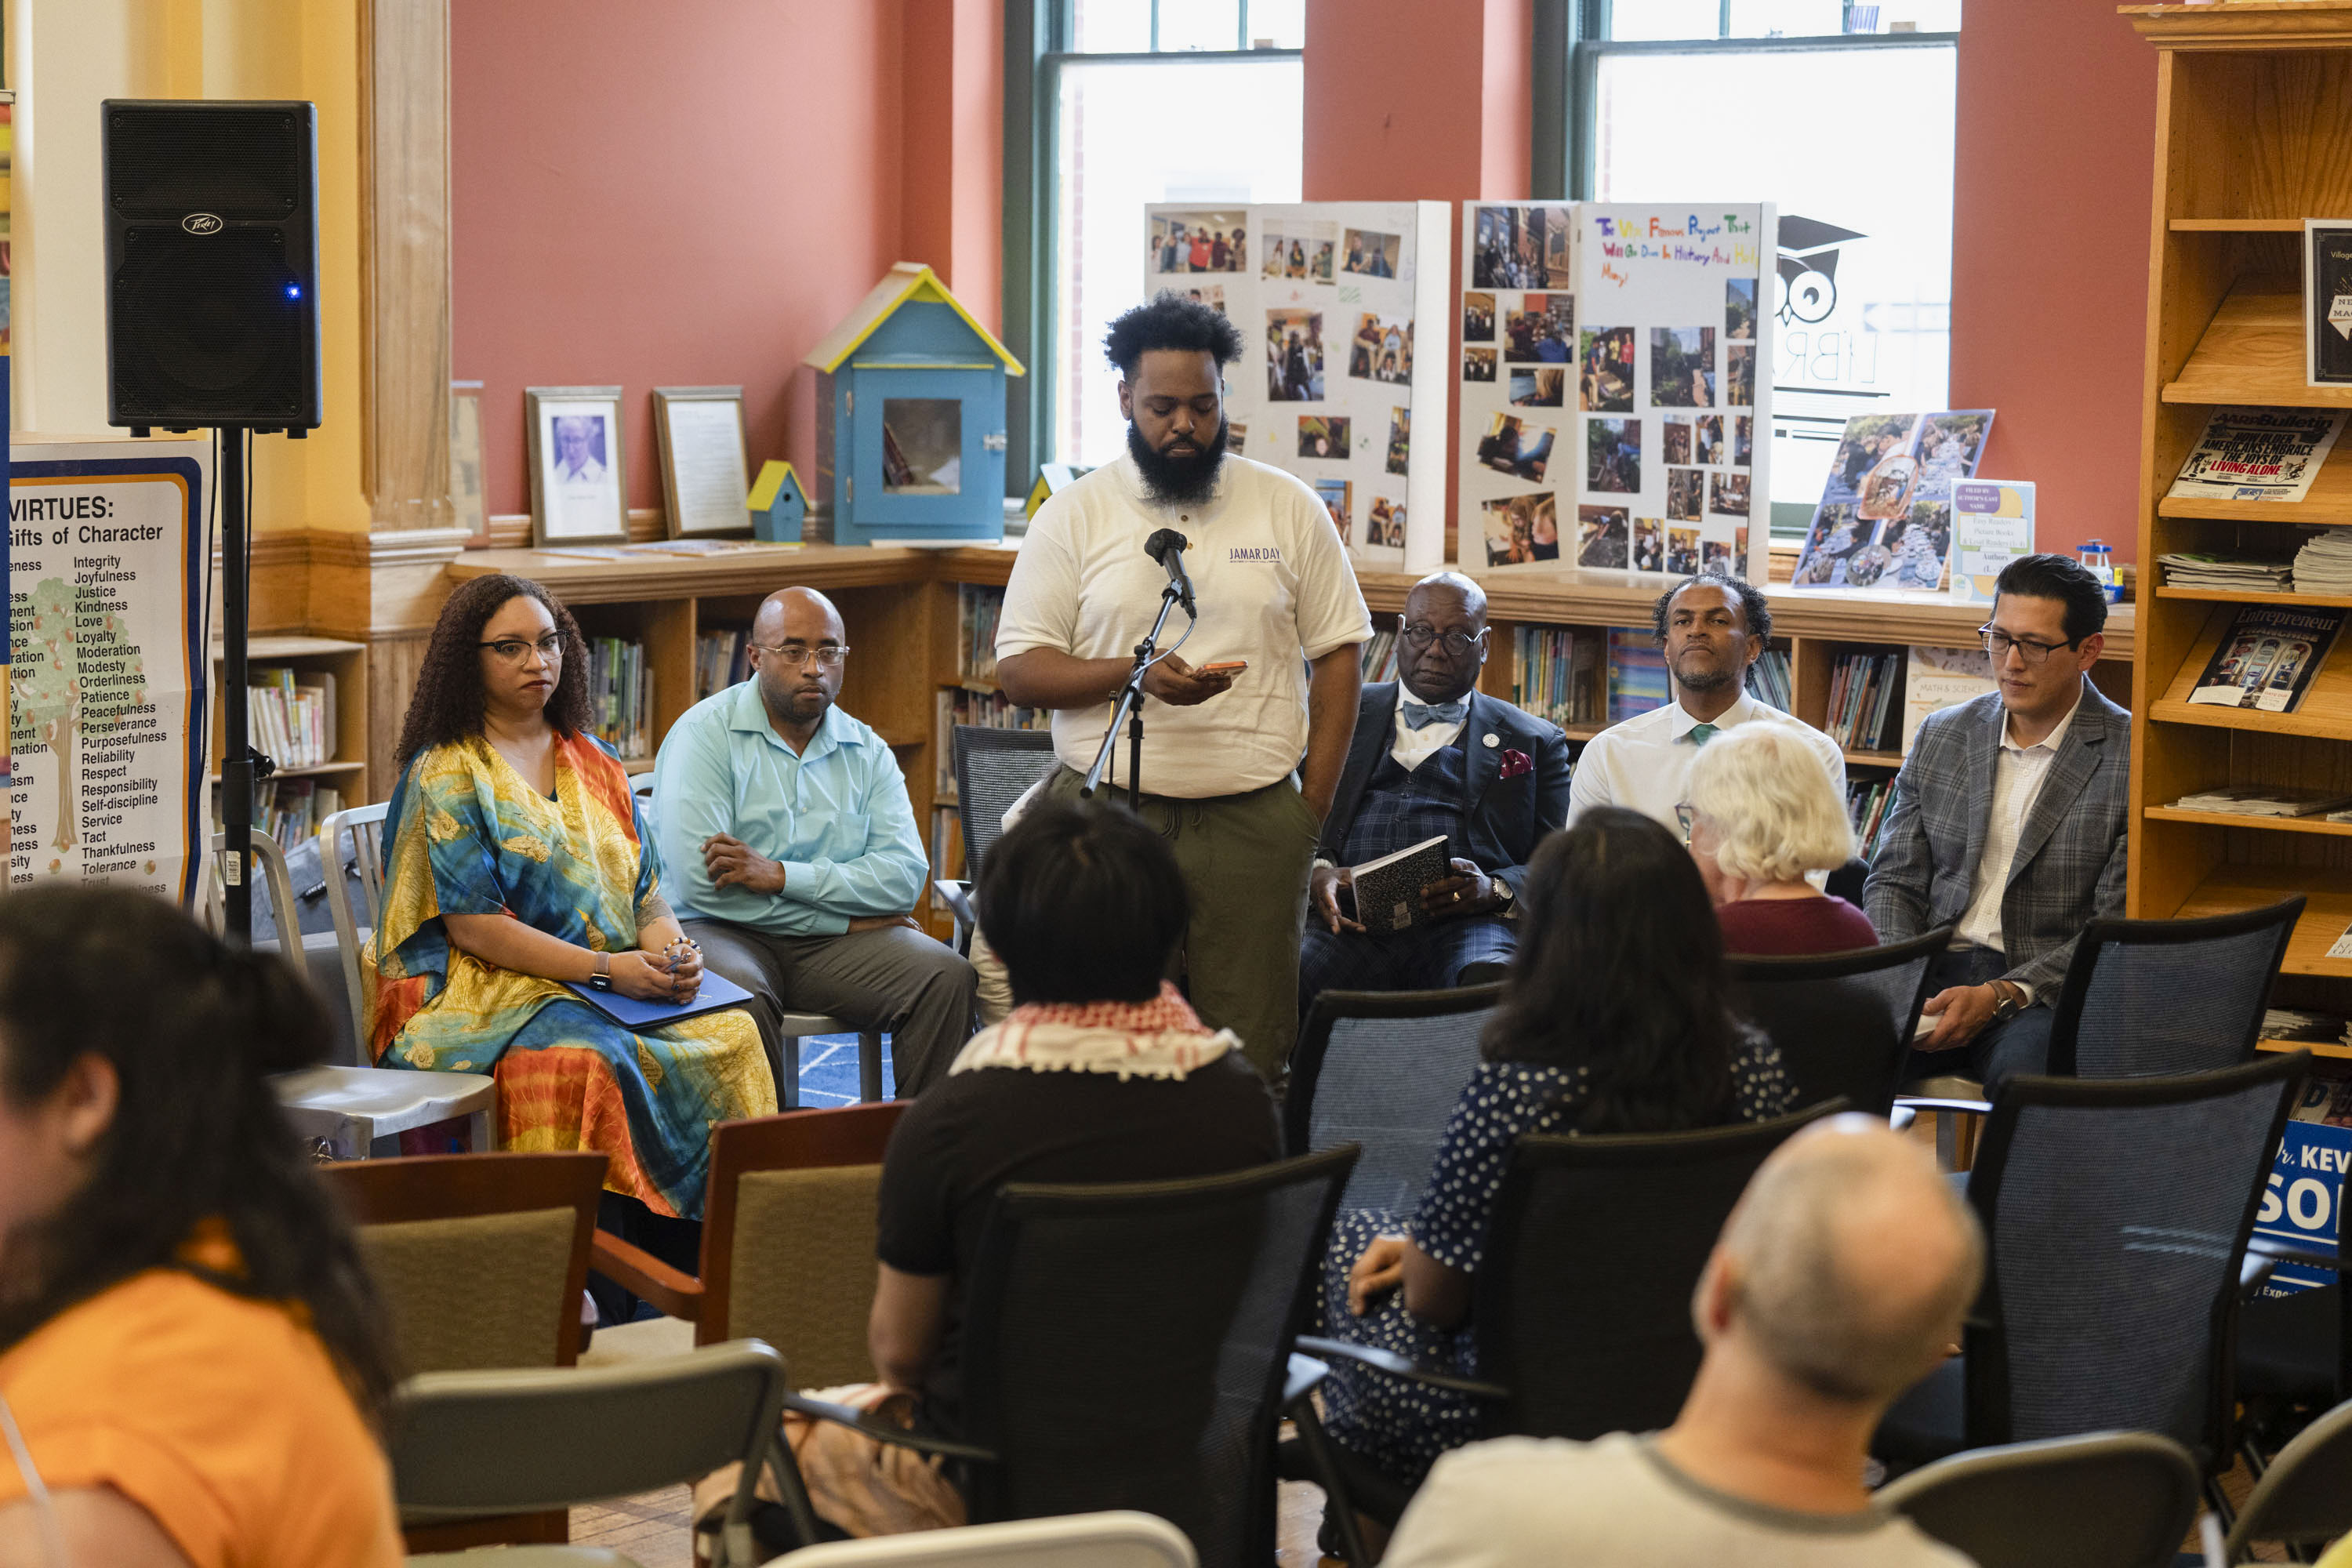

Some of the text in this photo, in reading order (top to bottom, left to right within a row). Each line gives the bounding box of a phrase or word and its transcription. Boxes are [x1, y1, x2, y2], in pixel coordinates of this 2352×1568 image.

[1595, 217, 1614, 236] The
[1602, 242, 1624, 258] Will
[2201, 439, 2315, 456] AMERICANS EMBRACE
[2220, 452, 2285, 466] THE JOYS OF
[2209, 460, 2283, 475] LIVING ALONE
[9, 495, 113, 521] VIRTUES:
[53, 527, 69, 545] of
[78, 524, 163, 543] Character
[1229, 547, 1279, 560] JAMAR DAY
[74, 555, 121, 570] Integrity
[74, 571, 136, 586] Joyfulness
[75, 586, 116, 598] Justice
[75, 600, 128, 613] Kindness
[75, 616, 103, 627] Love
[2235, 608, 2338, 630] Entrepreneur
[76, 631, 117, 645] Loyalty
[77, 644, 140, 659] Moderation
[78, 660, 125, 674] Modesty
[80, 673, 146, 688] Orderliness
[81, 690, 129, 703] Patience
[82, 703, 156, 718] Peacefulness
[82, 717, 157, 734] Perseverance
[82, 731, 167, 750] Purposefulness
[82, 750, 135, 765] Reliability
[82, 765, 126, 781] Respect
[82, 779, 158, 797] Responsibility
[82, 793, 158, 812] Self-discipline
[82, 814, 123, 828] Service
[82, 831, 107, 844] Tact
[82, 840, 155, 859] Thankfulness
[82, 859, 136, 876] Tolerance
[2256, 1173, 2344, 1233] SO
